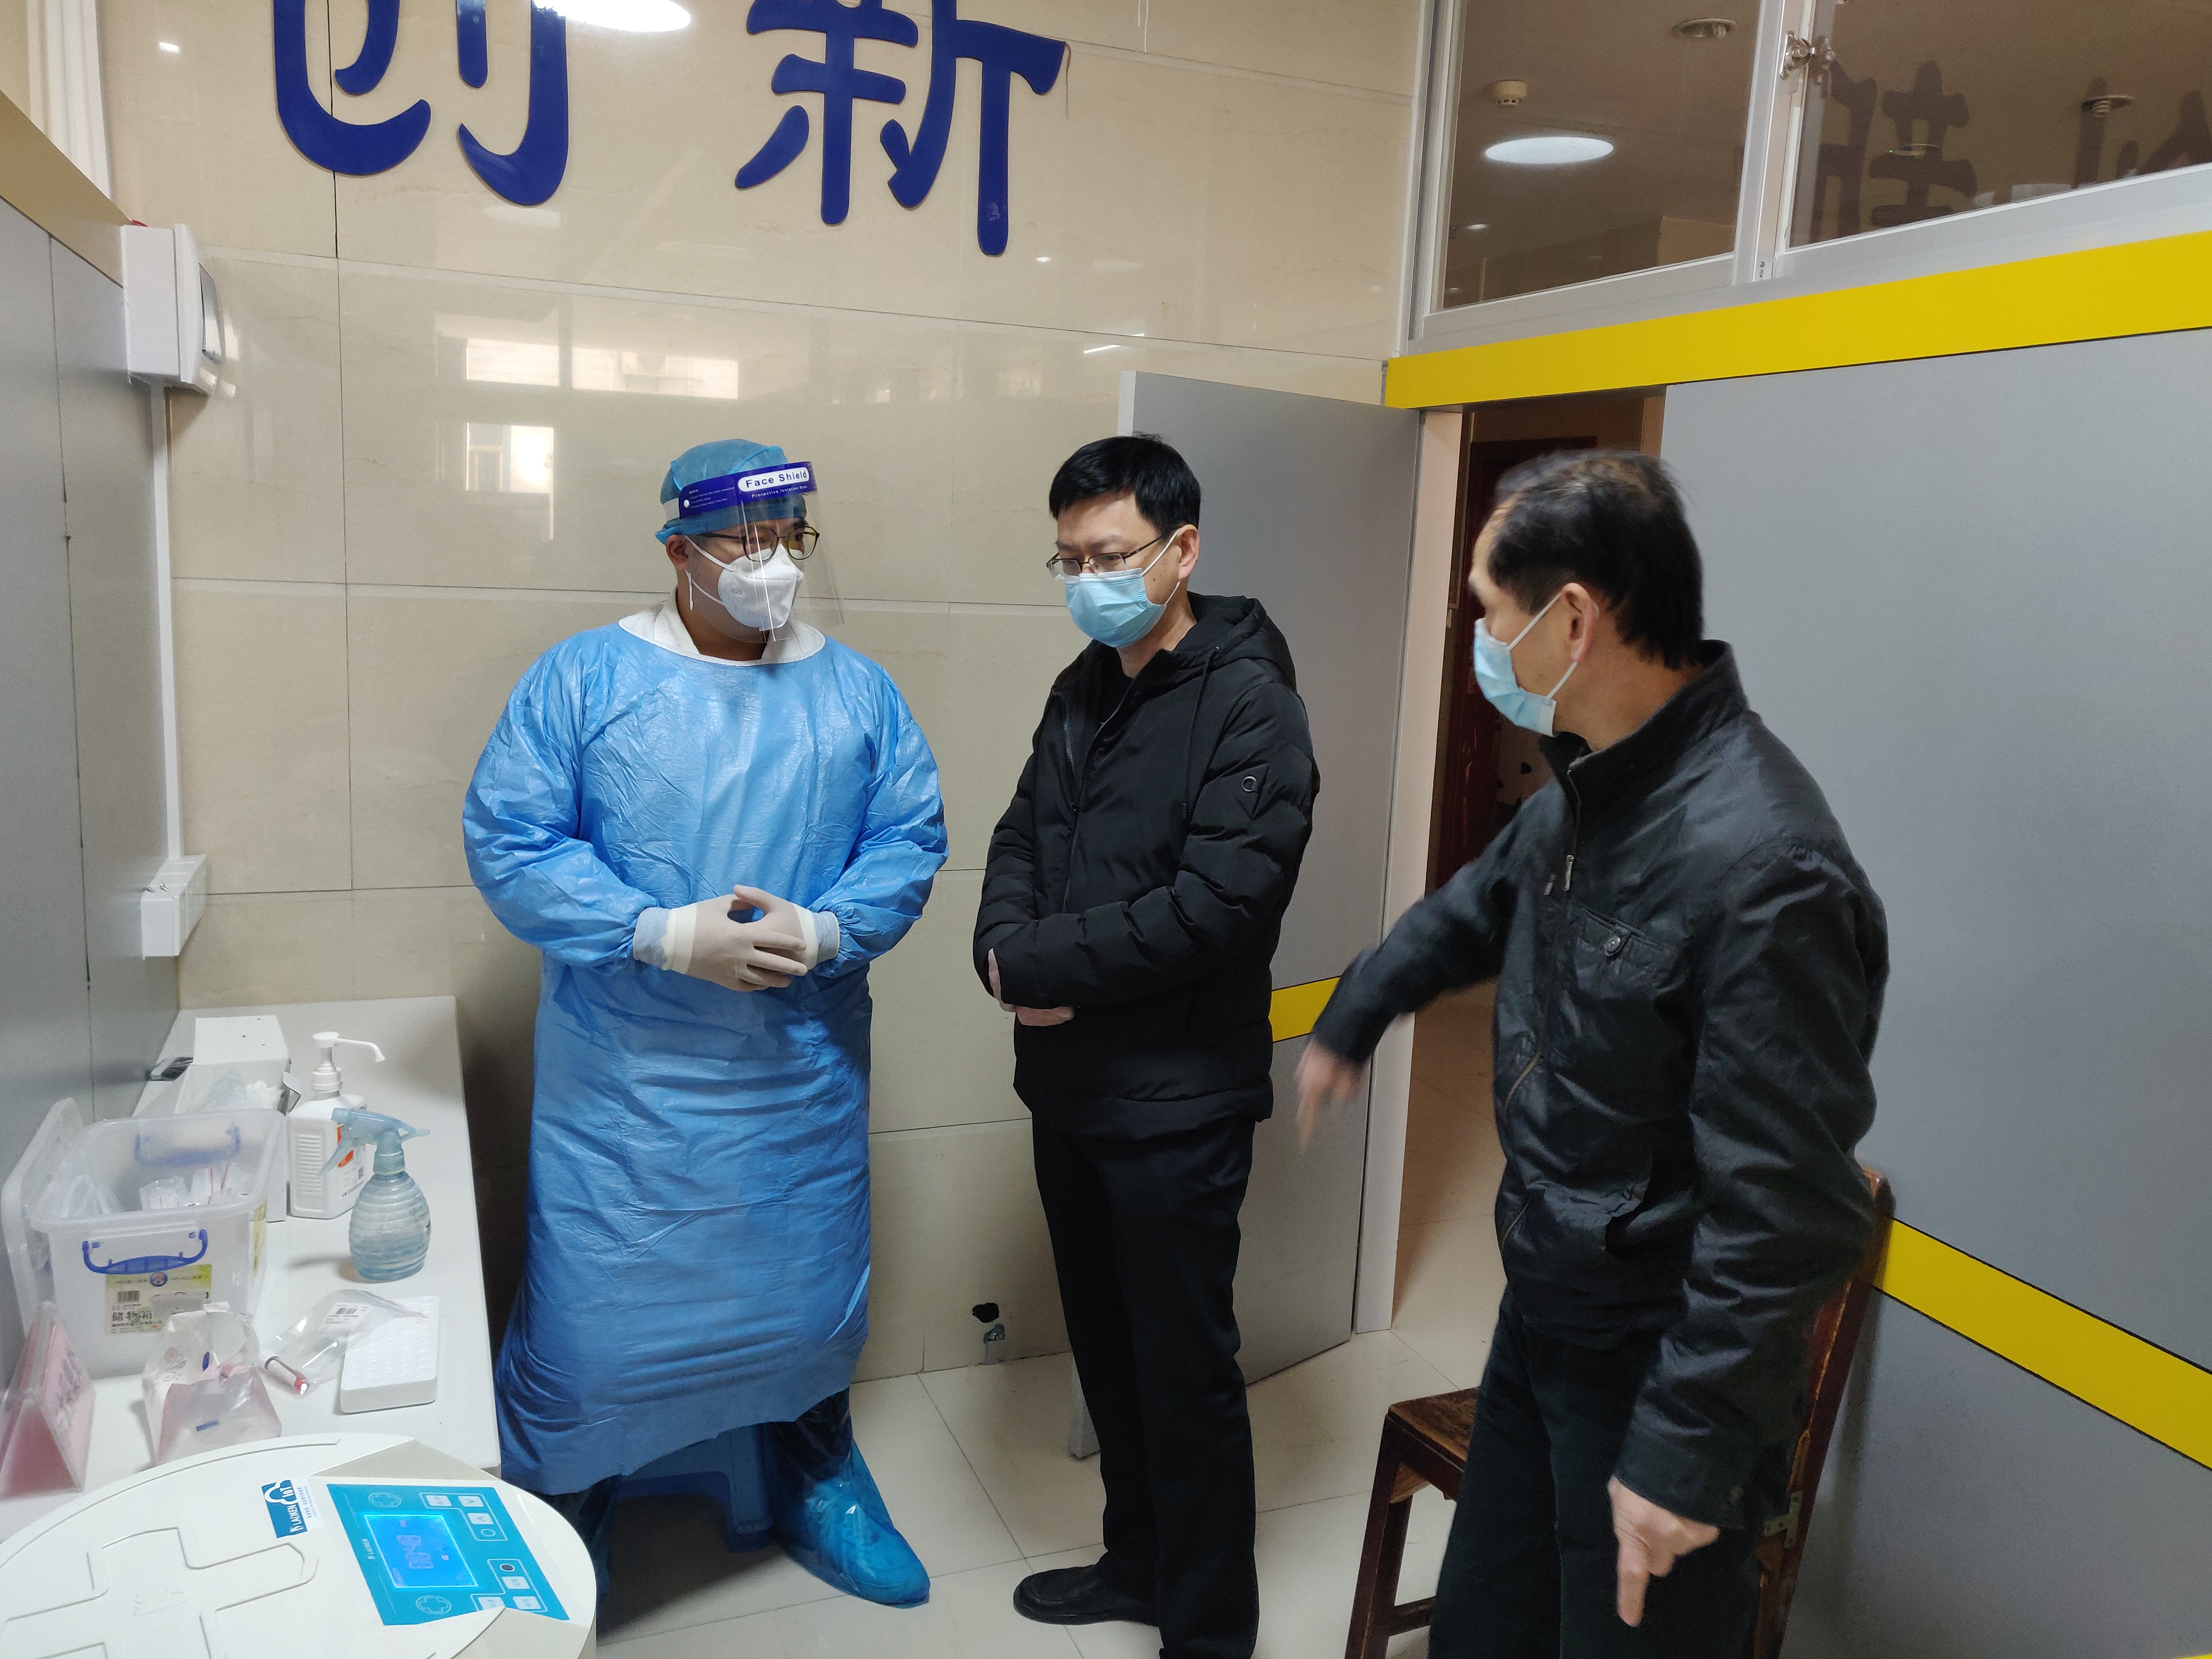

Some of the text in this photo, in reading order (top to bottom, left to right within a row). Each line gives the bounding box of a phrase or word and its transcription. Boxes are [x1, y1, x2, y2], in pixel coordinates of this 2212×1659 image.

[745, 478, 774, 488] Face
[779, 470, 807, 482] Shield
[751, 490, 779, 498] Protective
